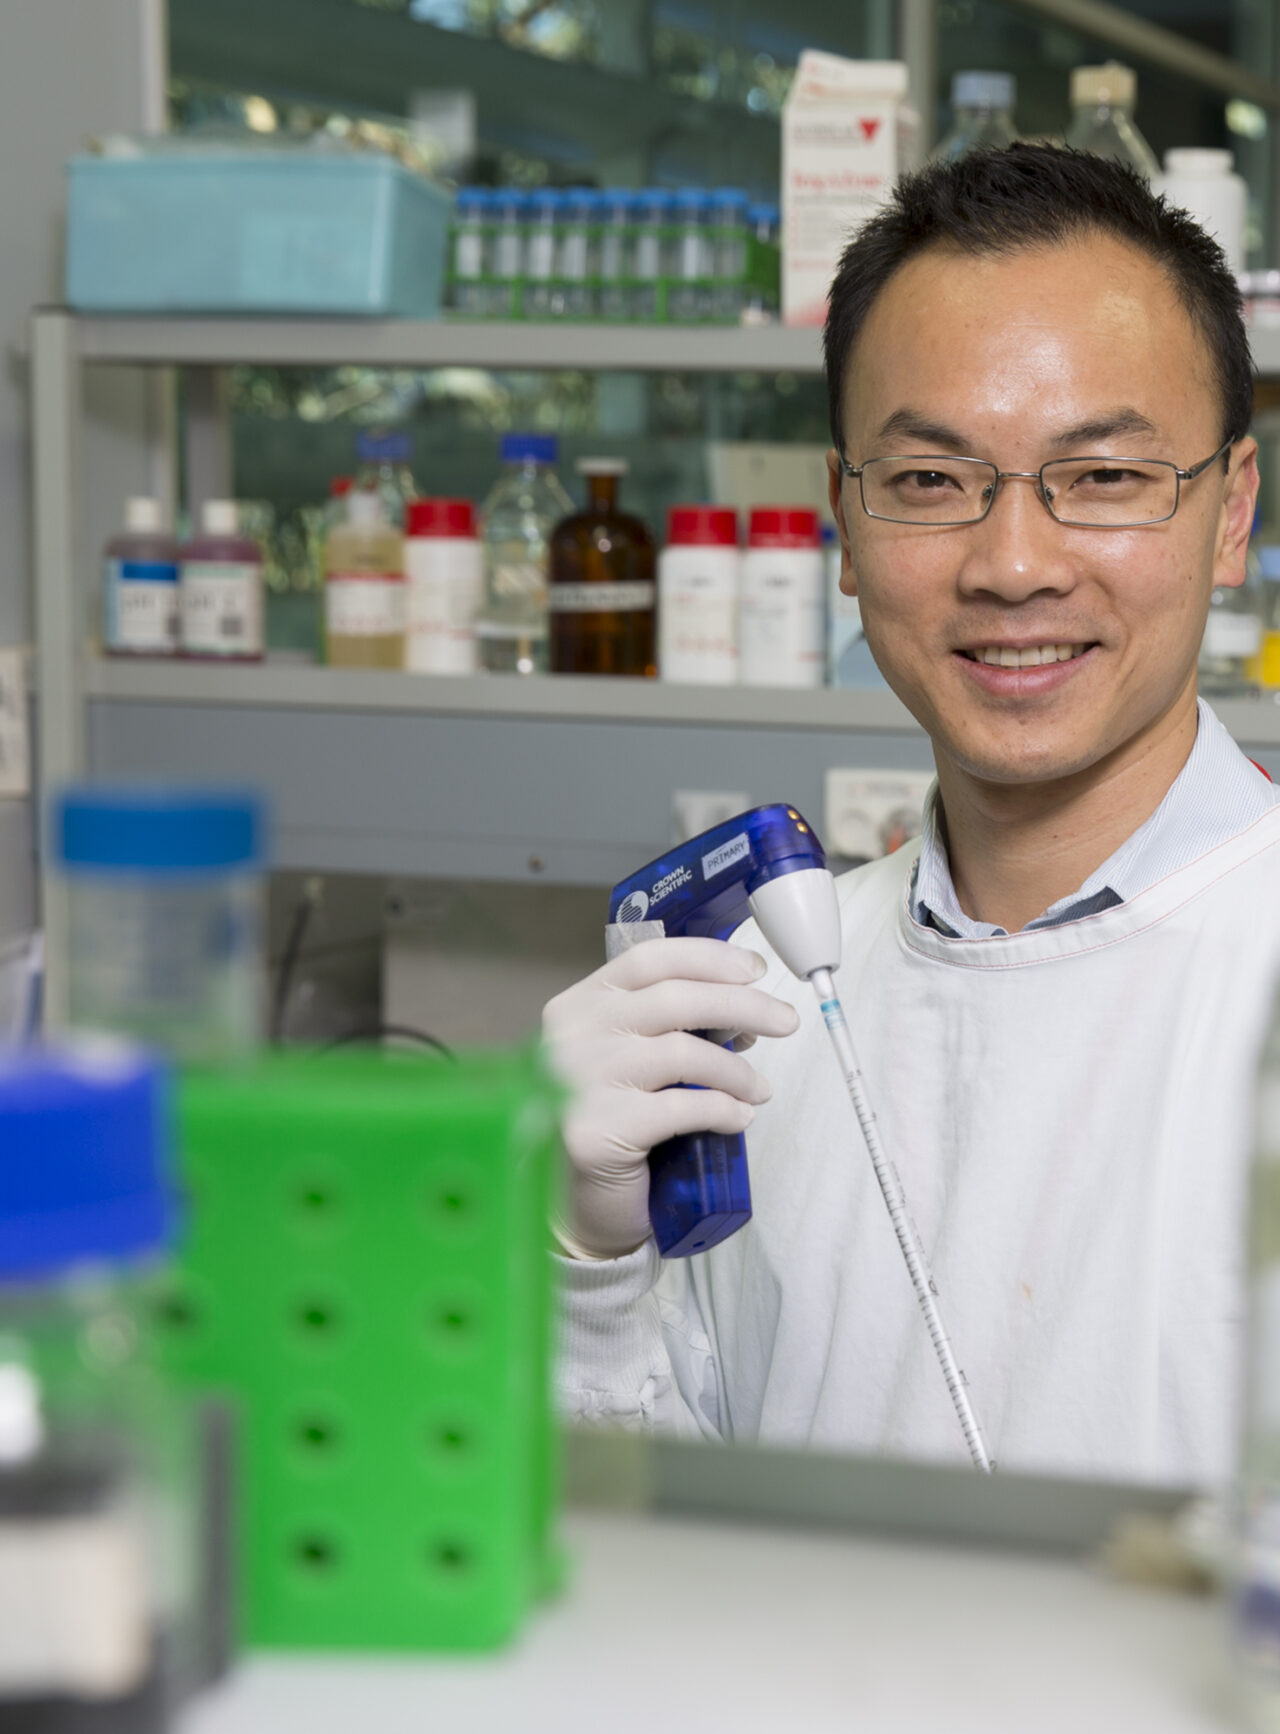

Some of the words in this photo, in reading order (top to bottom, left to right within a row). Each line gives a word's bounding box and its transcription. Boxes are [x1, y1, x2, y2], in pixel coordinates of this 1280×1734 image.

[707, 841, 746, 870] PRIMARY
[649, 869, 693, 907] SCIENTIFIC
[652, 865, 685, 894] CROWN
